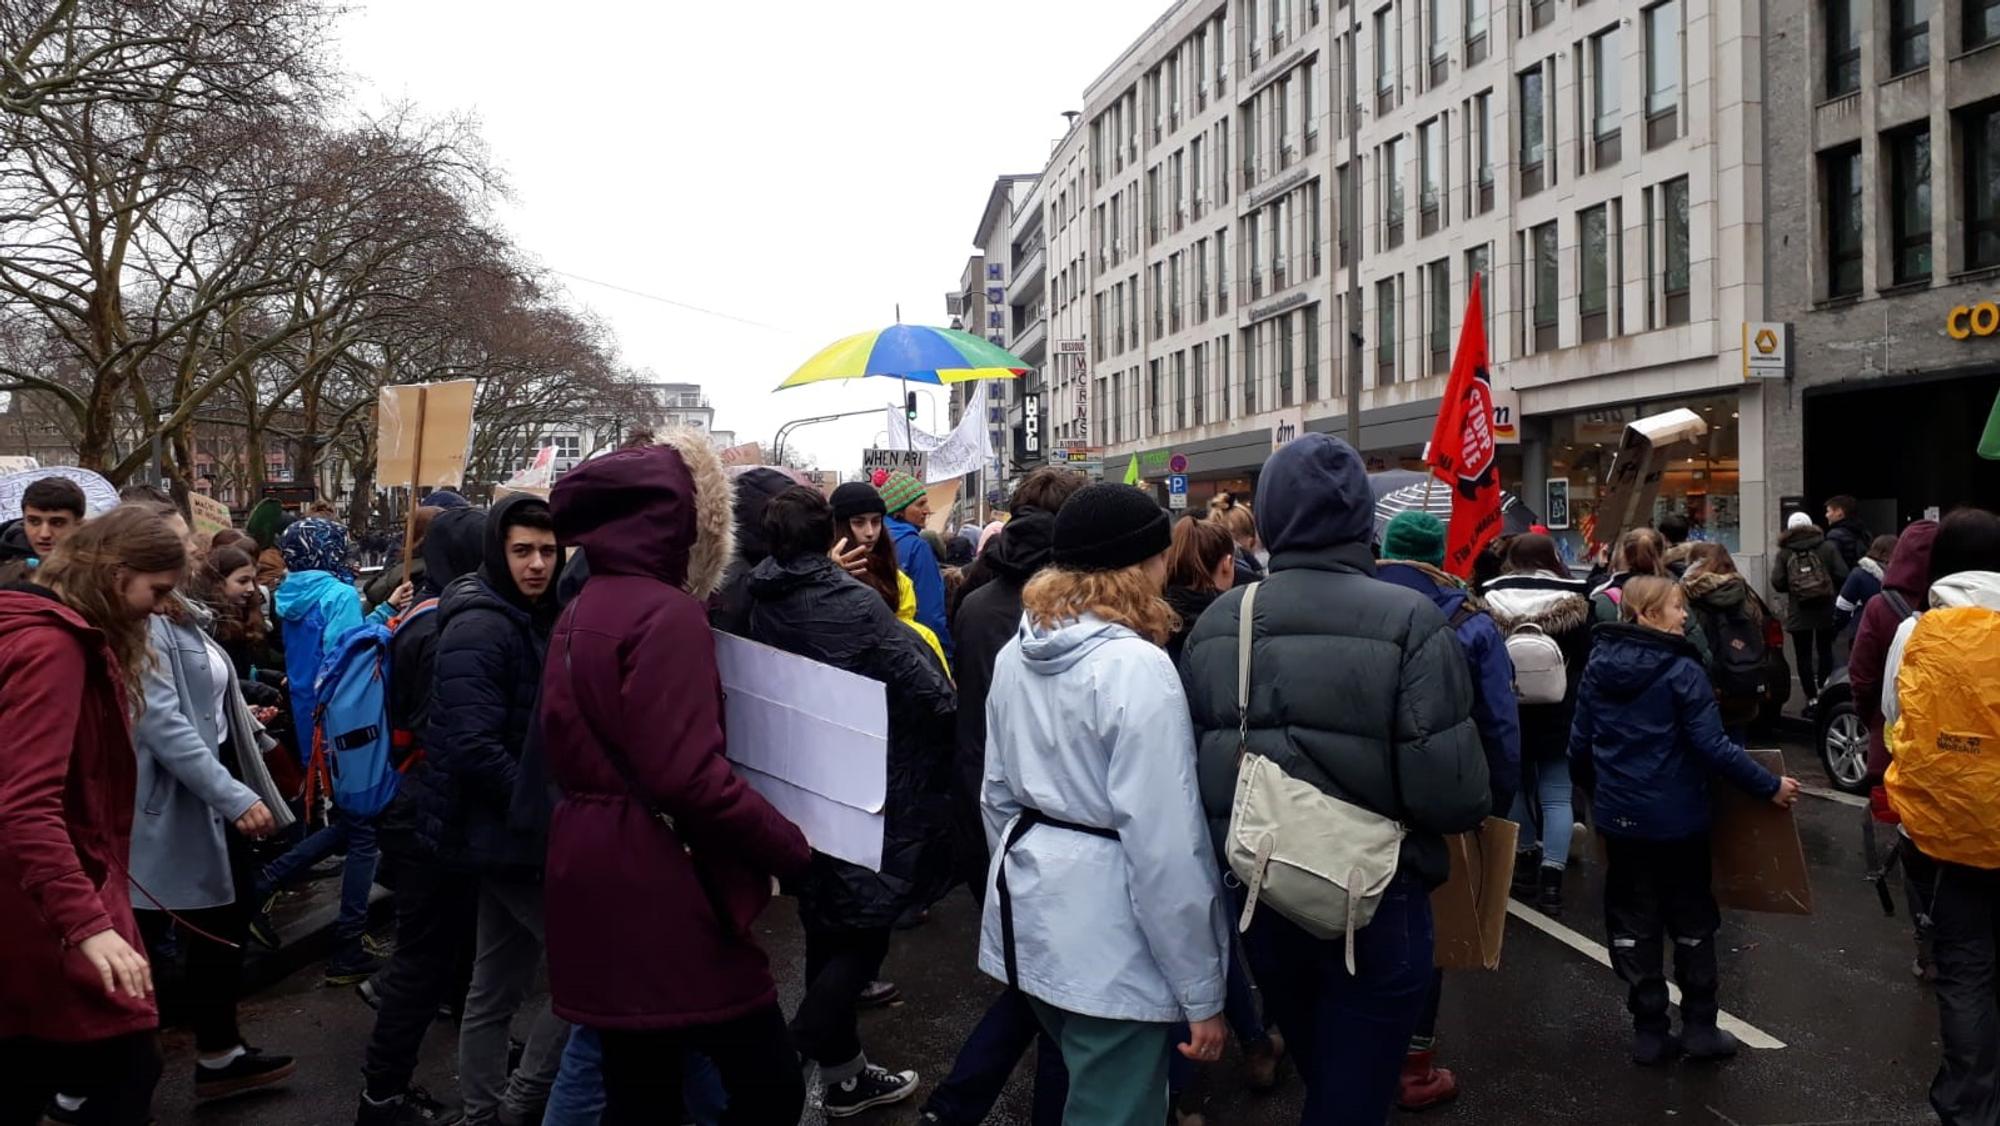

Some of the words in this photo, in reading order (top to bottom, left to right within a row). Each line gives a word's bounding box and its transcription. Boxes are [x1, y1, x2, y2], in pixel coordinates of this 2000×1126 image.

[1277, 419, 1295, 442] dm
[864, 451, 899, 466] WHEN
[1173, 477, 1184, 492] P
